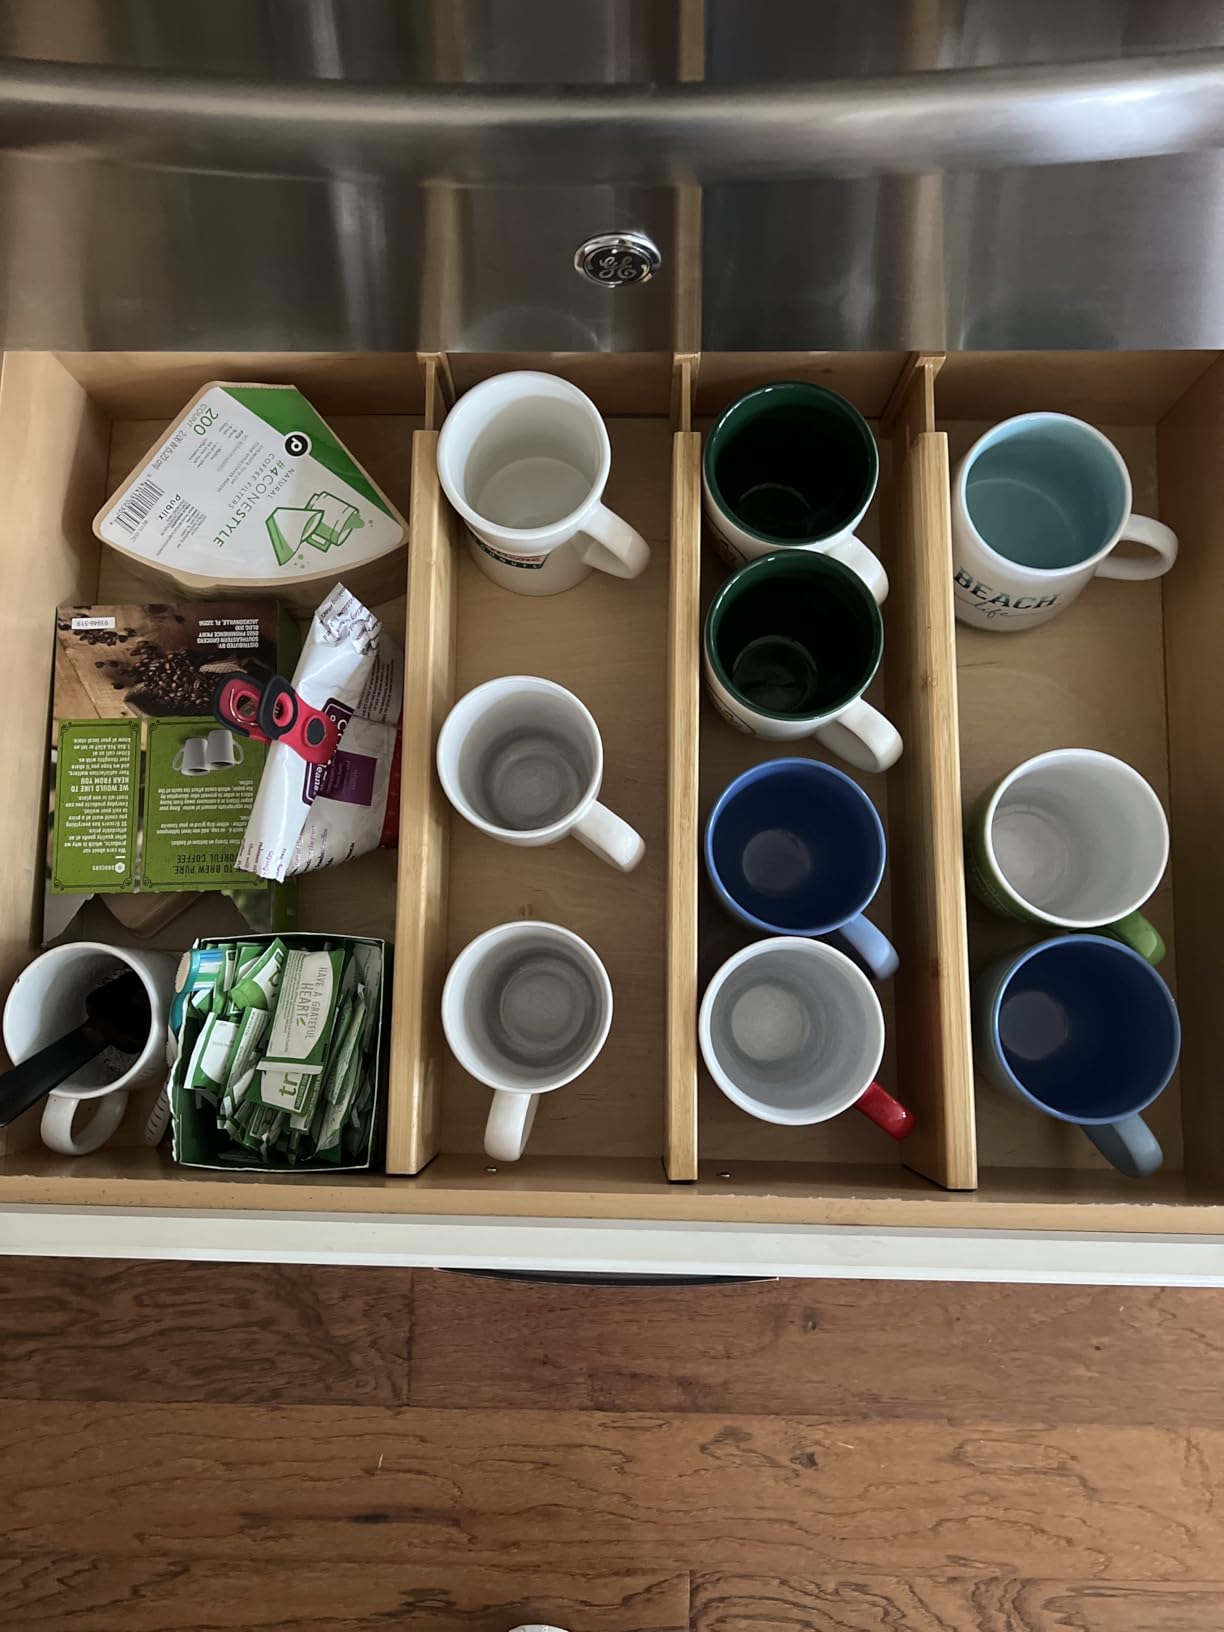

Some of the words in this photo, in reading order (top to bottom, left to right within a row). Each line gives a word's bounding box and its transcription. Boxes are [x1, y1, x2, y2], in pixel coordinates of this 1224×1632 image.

[185, 402, 208, 428] COUNT
[191, 407, 219, 438] 200
[250, 452, 276, 482] COFFEE
[227, 481, 252, 510] FILTERS
[266, 467, 295, 500] NATURAL
[157, 493, 182, 522] Publix
[954, 566, 1061, 609] BEACH
[177, 854, 206, 863] COFFEE
[199, 865, 220, 873] BREW
[210, 853, 239, 863] VORFUL
[223, 865, 233, 873] TO
[316, 968, 329, 988] HAVE
[296, 983, 314, 1018] HEART
[305, 999, 321, 1040] GRATEFUL
